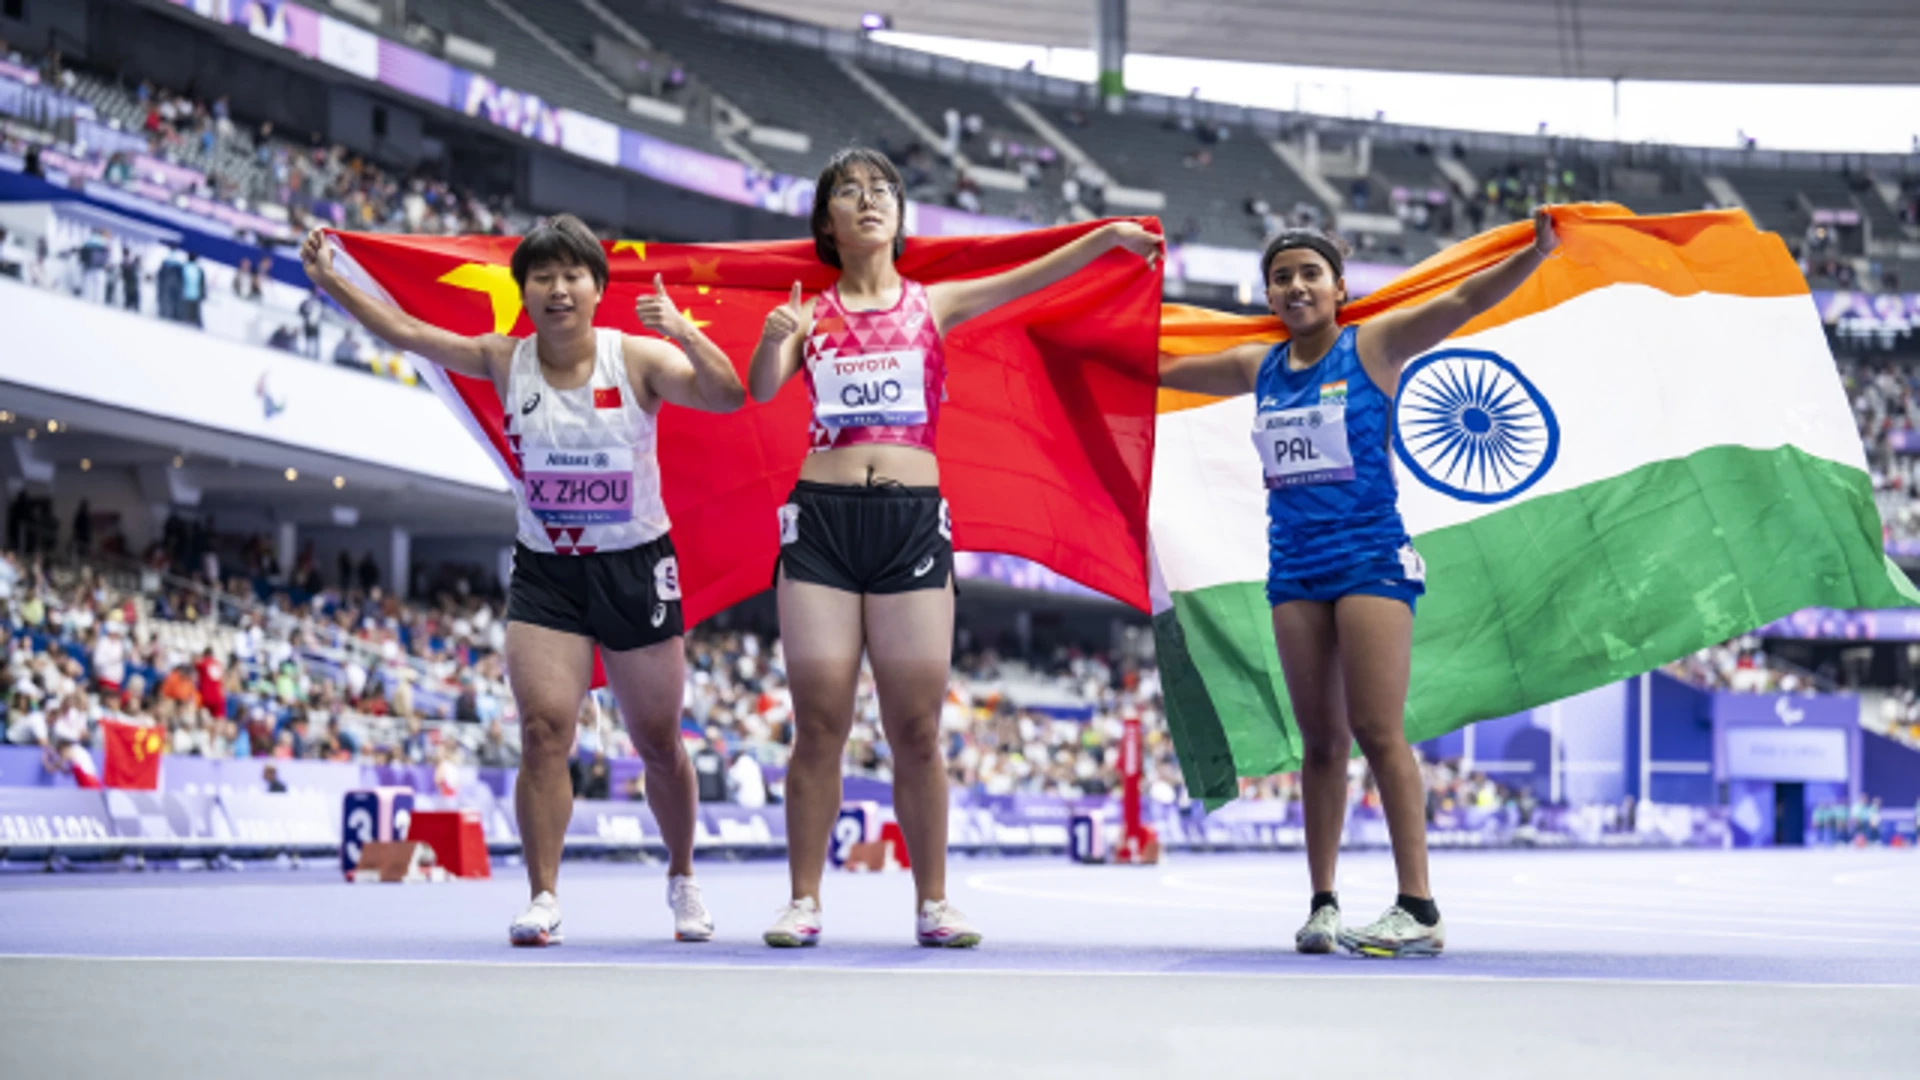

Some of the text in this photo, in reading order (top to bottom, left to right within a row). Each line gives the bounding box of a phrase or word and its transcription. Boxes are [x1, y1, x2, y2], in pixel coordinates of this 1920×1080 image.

[834, 356, 900, 376] TOYOTA
[840, 378, 902, 408] GUO
[1274, 436, 1321, 465] PAL
[529, 479, 629, 505] X. ZHOU
[347, 806, 374, 865] 3
